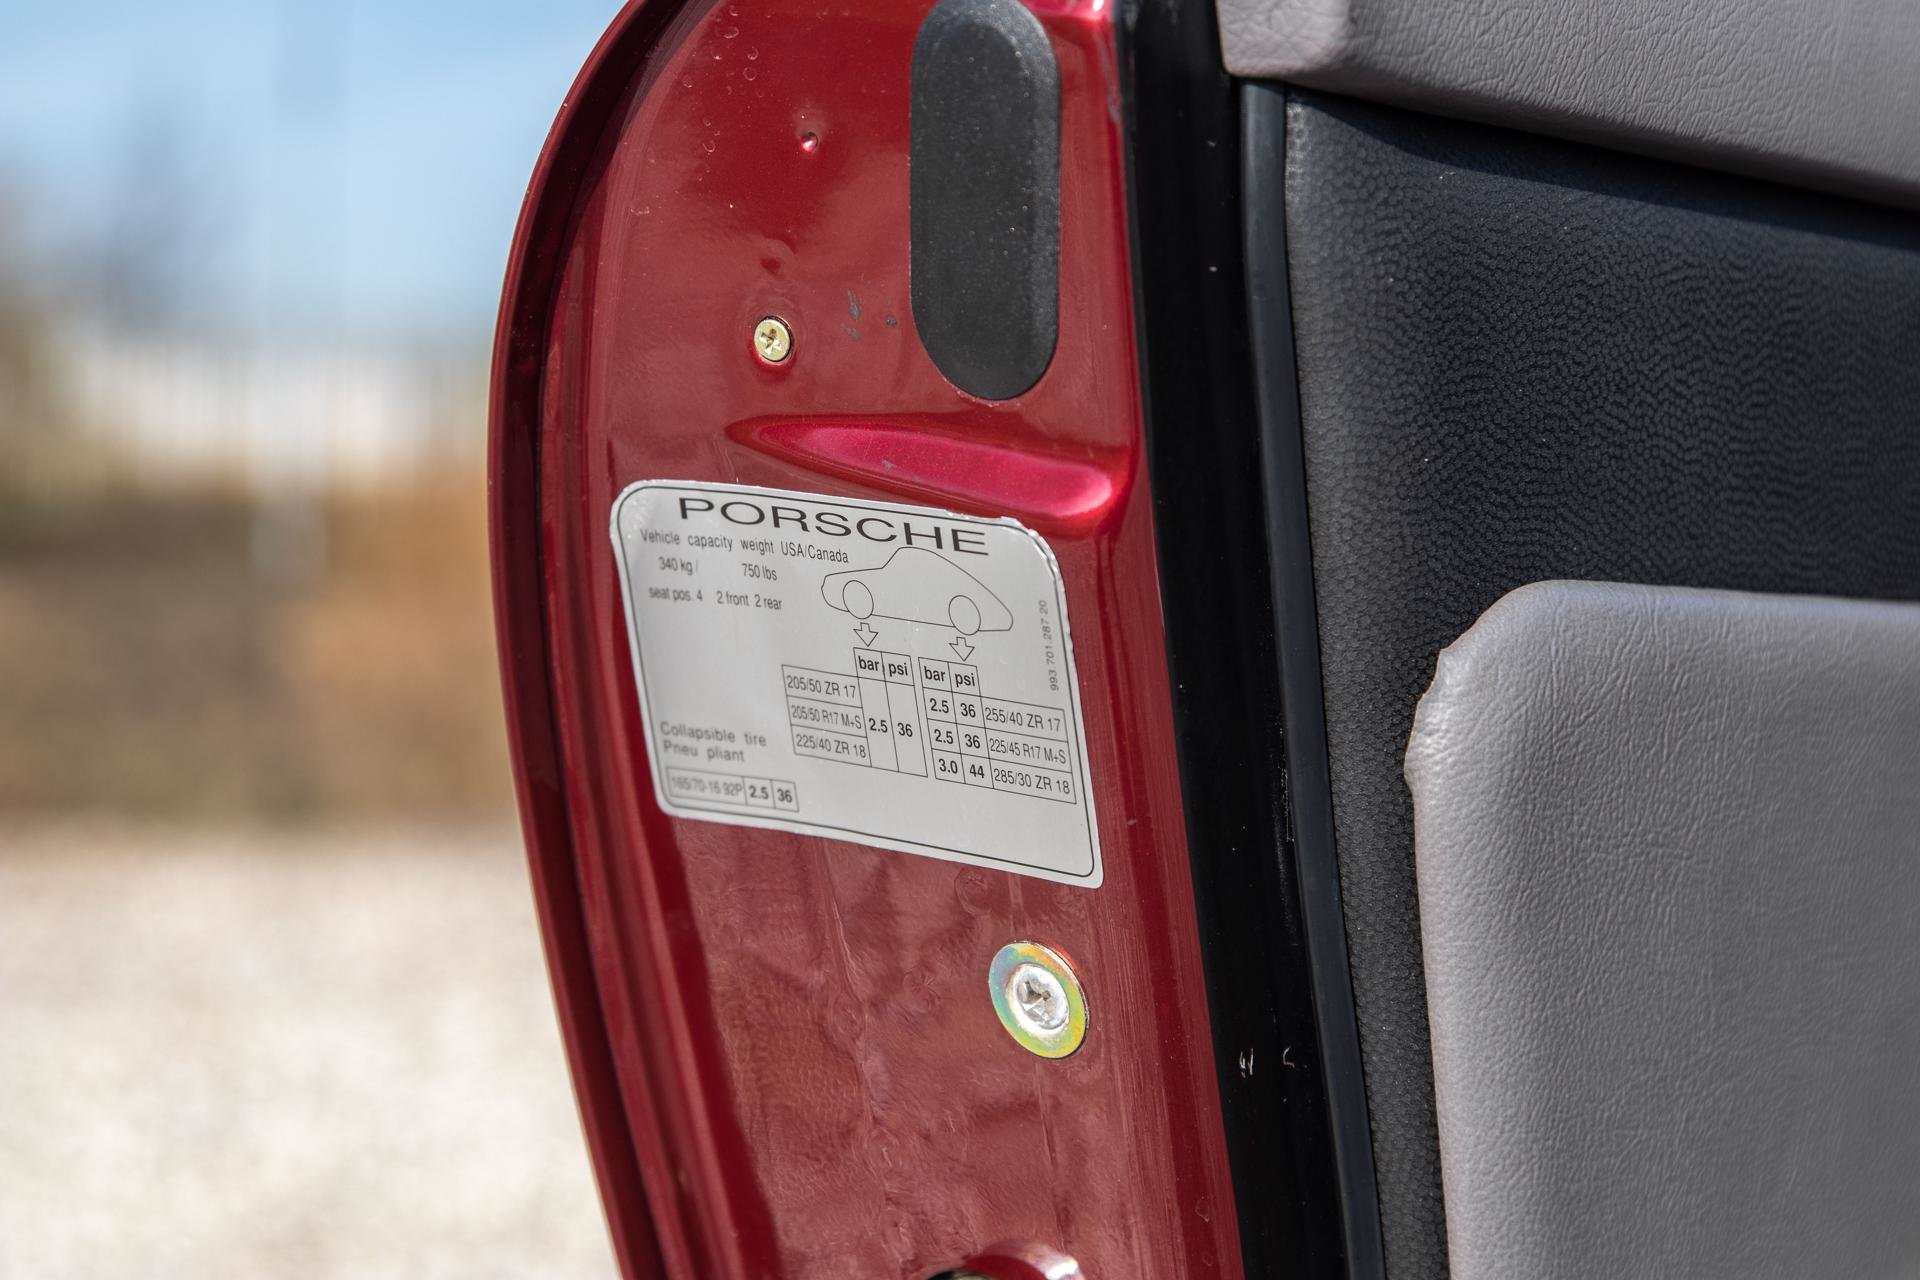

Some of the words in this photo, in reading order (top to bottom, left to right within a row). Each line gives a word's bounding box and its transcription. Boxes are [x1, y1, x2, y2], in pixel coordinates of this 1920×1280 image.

[679, 497, 989, 556] PORSCHE
[640, 529, 681, 545] Vehicle
[688, 533, 733, 551] capacity
[740, 538, 775, 555] weight
[780, 541, 849, 564] USA/Canada
[658, 556, 678, 571] 340
[680, 558, 693, 576] kg
[741, 563, 760, 578] 750
[762, 565, 778, 581] lbs
[648, 587, 670, 600] seat
[697, 589, 704, 601] 4
[716, 590, 723, 604] 2
[725, 591, 750, 607] front
[754, 594, 761, 607] 2
[763, 597, 782, 610] rear
[858, 655, 880, 672] bar
[888, 662, 909, 677] psi
[924, 666, 946, 682] bar
[954, 672, 976, 688] psi
[786, 675, 822, 693] 205/50
[824, 681, 840, 696] ZR
[844, 685, 856, 698] 17
[791, 705, 820, 723] 205/50
[822, 710, 839, 725] R17
[841, 713, 862, 729] M+S
[929, 698, 949, 713] 2.5
[960, 703, 976, 718] 36
[868, 718, 888, 733] 2.5
[897, 722, 913, 737] 36
[985, 707, 1023, 726] 255/40
[1026, 713, 1044, 730] ZR
[1047, 718, 1061, 732] 17
[660, 721, 736, 743] Collapsible
[744, 732, 767, 747] tire
[934, 728, 953, 744] 2.5
[964, 734, 980, 749] 36
[662, 740, 699, 757] Pneu
[707, 746, 745, 763] pliant
[796, 734, 831, 752] 225/40
[834, 740, 850, 755] ZR
[853, 745, 866, 758] 18
[989, 737, 1020, 758] 225/45
[1022, 743, 1041, 759] R17
[1044, 747, 1066, 764] M+S
[938, 758, 958, 774] 3.0
[969, 764, 984, 779] 44
[993, 768, 1032, 787] 285/30
[1035, 775, 1052, 791] ZR
[1056, 780, 1070, 794] 18
[749, 785, 769, 799] 2.5
[777, 788, 793, 803] 36
